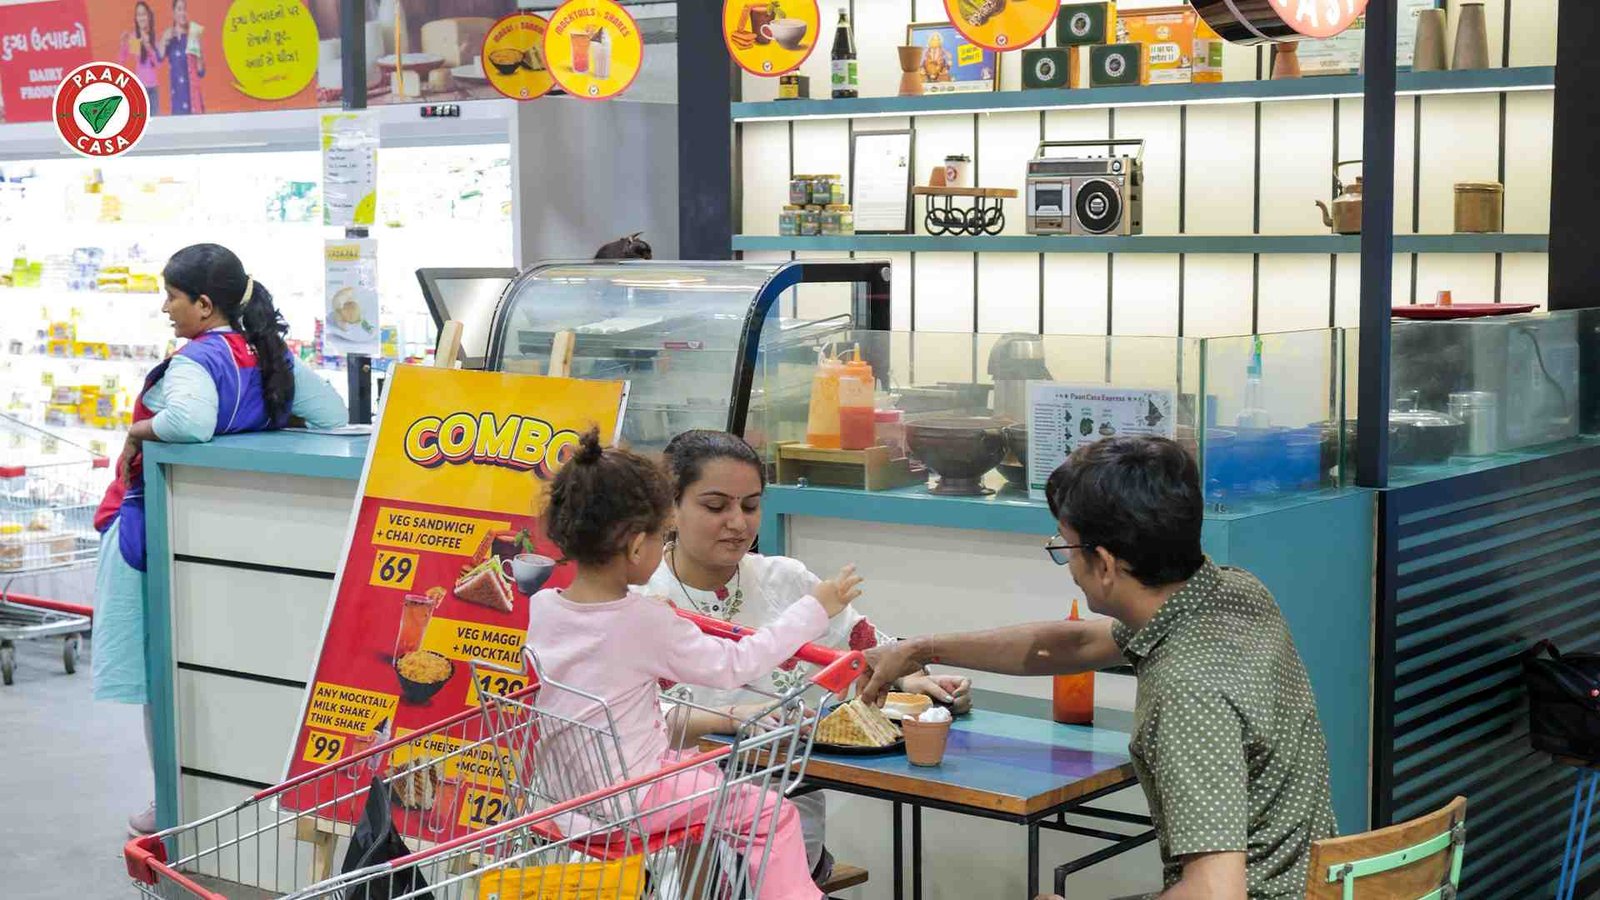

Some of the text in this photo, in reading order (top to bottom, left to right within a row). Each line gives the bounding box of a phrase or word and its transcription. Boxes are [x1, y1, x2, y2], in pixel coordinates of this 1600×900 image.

[386, 529, 413, 540] CHAI
[389, 514, 475, 535] VEG SANDWICH
[457, 627, 521, 647] VEG MAGGI
[461, 643, 521, 663] MOCKTAIL
[317, 687, 338, 698] ANY
[339, 691, 387, 708] MOCKTAIL
[313, 700, 338, 712] MILK
[339, 705, 371, 719] SHAKE
[311, 712, 366, 731] THIK SHAKE
